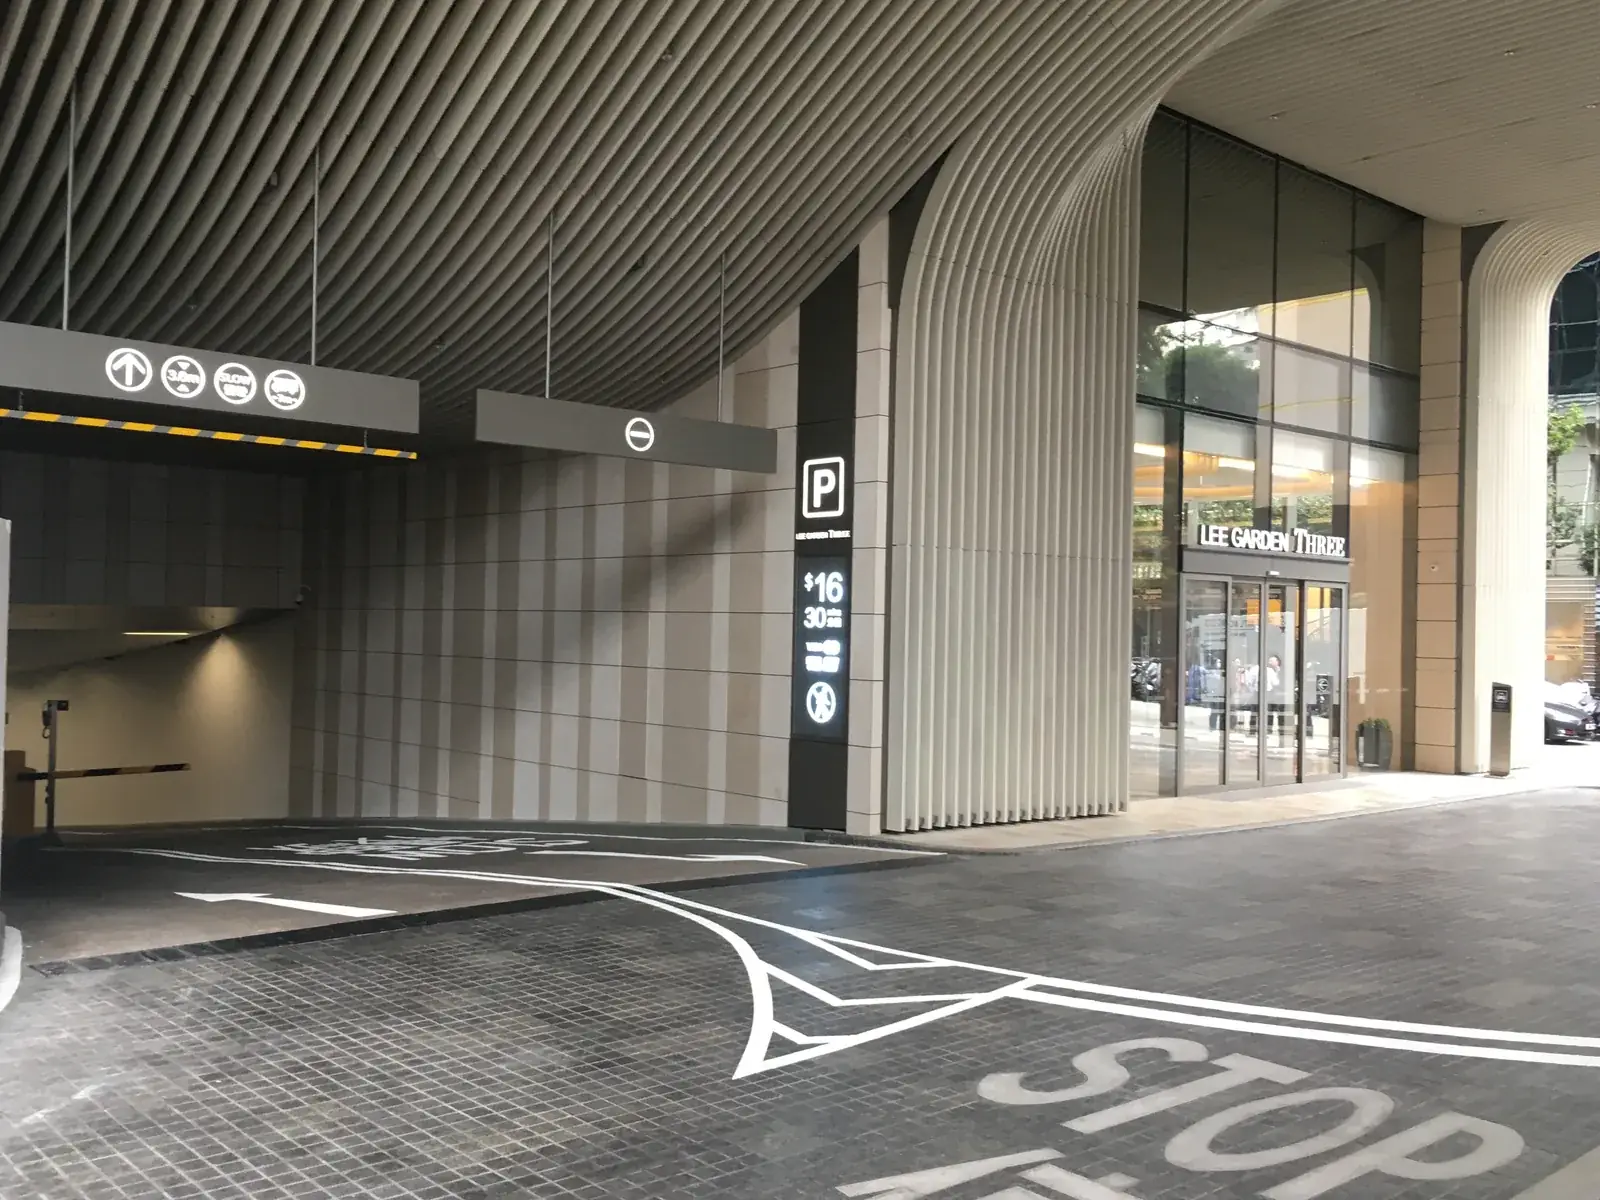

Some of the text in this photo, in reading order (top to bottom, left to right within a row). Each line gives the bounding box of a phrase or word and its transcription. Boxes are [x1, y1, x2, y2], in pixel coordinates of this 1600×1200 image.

[813, 469, 836, 508] P
[1200, 524, 1346, 557] LEE GARDEN THREE
[804, 571, 844, 604] $16
[803, 607, 827, 629] 30
[976, 1037, 1525, 1200] STOP
